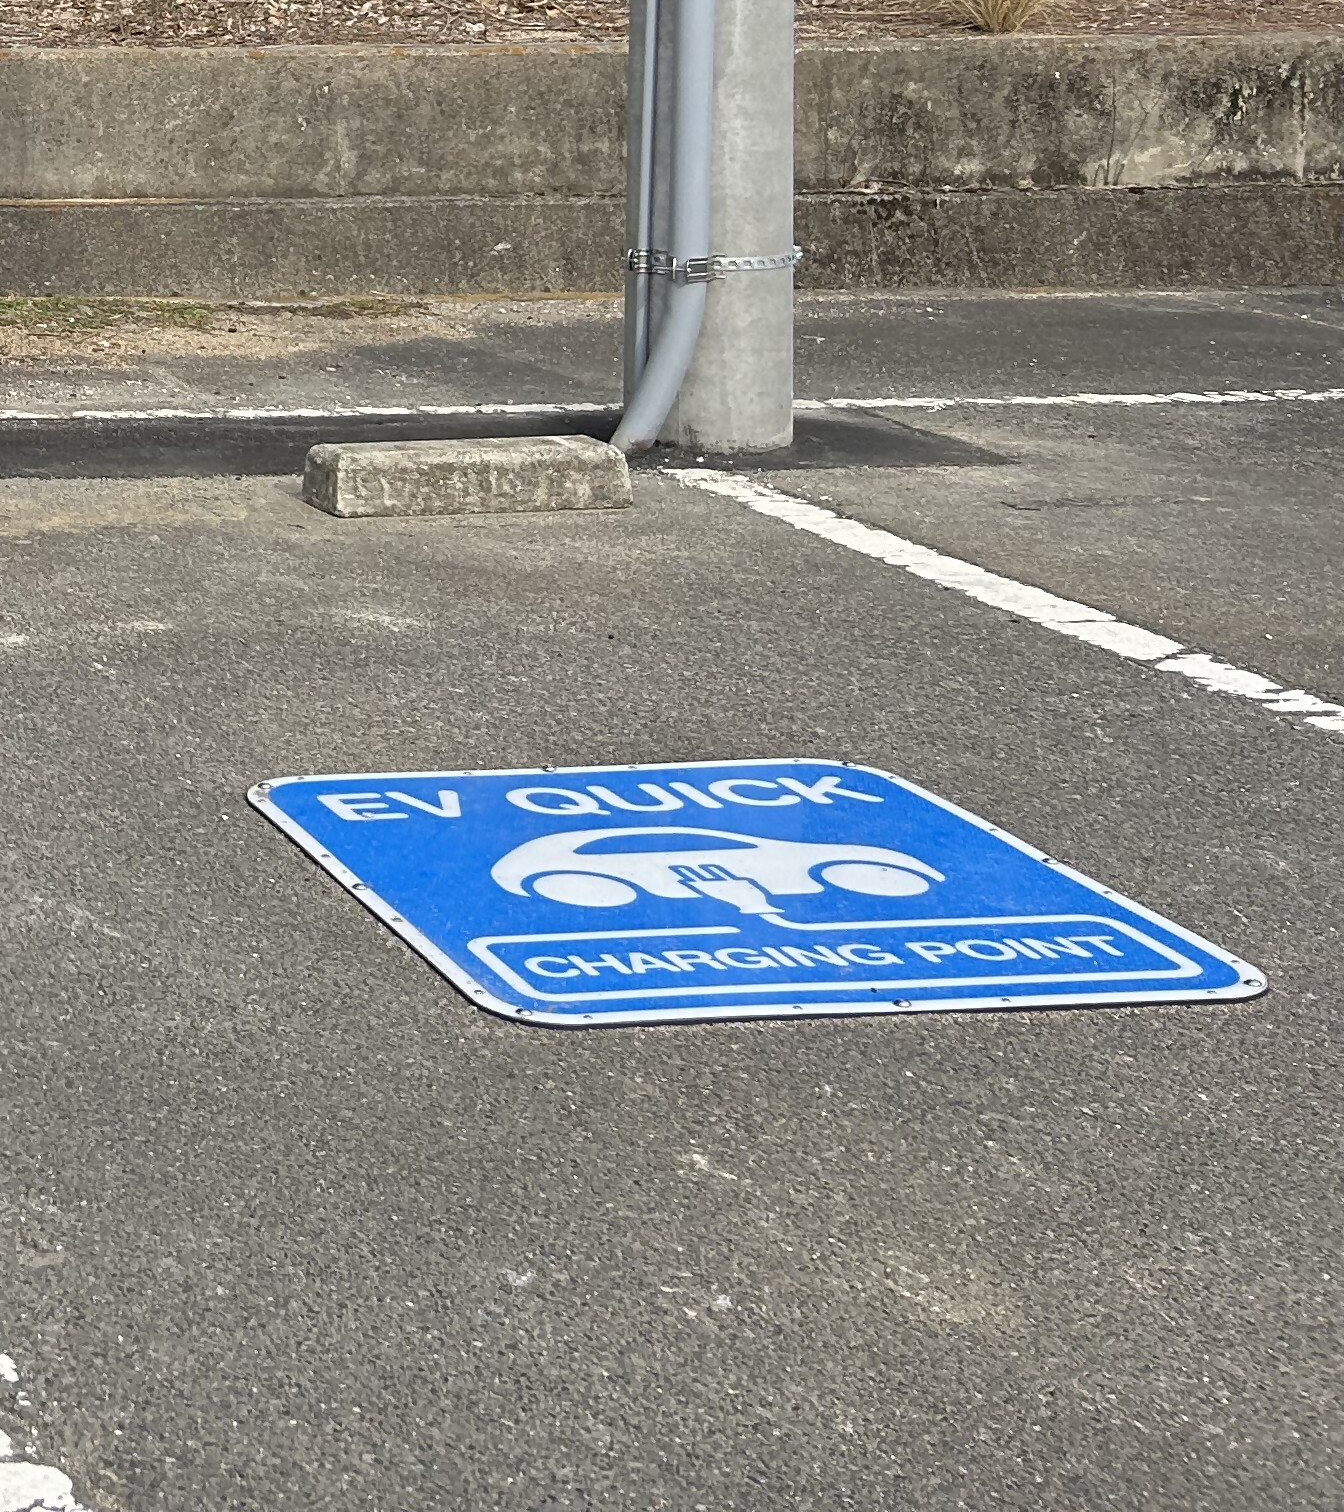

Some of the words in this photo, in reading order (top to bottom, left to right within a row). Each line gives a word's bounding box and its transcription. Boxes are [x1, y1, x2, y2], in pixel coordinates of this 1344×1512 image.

[316, 790, 462, 821] EV
[505, 776, 885, 816] QUICK
[523, 942, 905, 979] CHARGING
[905, 934, 1126, 964] POINT
